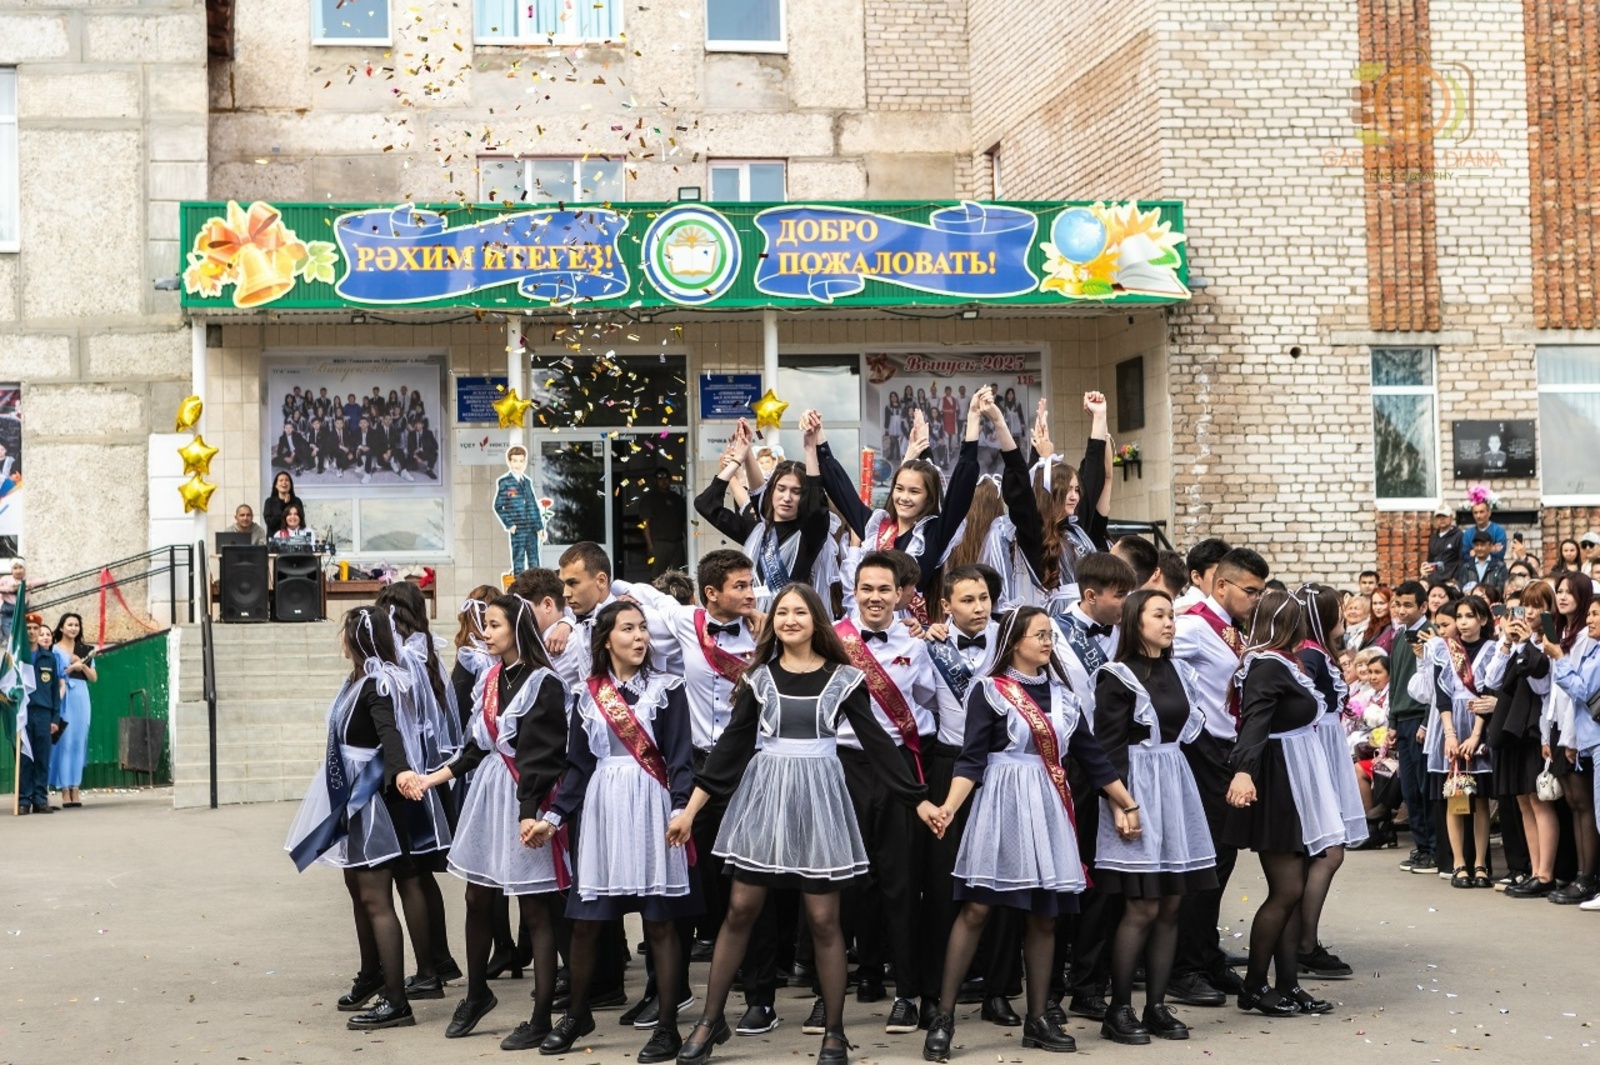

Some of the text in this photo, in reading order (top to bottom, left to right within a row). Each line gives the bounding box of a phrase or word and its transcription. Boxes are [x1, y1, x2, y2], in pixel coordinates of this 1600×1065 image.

[776, 219, 879, 247] ДОБРО
[355, 246, 475, 271] РӘХИМ
[777, 251, 997, 275] ПОЖАЛОВАТЬ!
